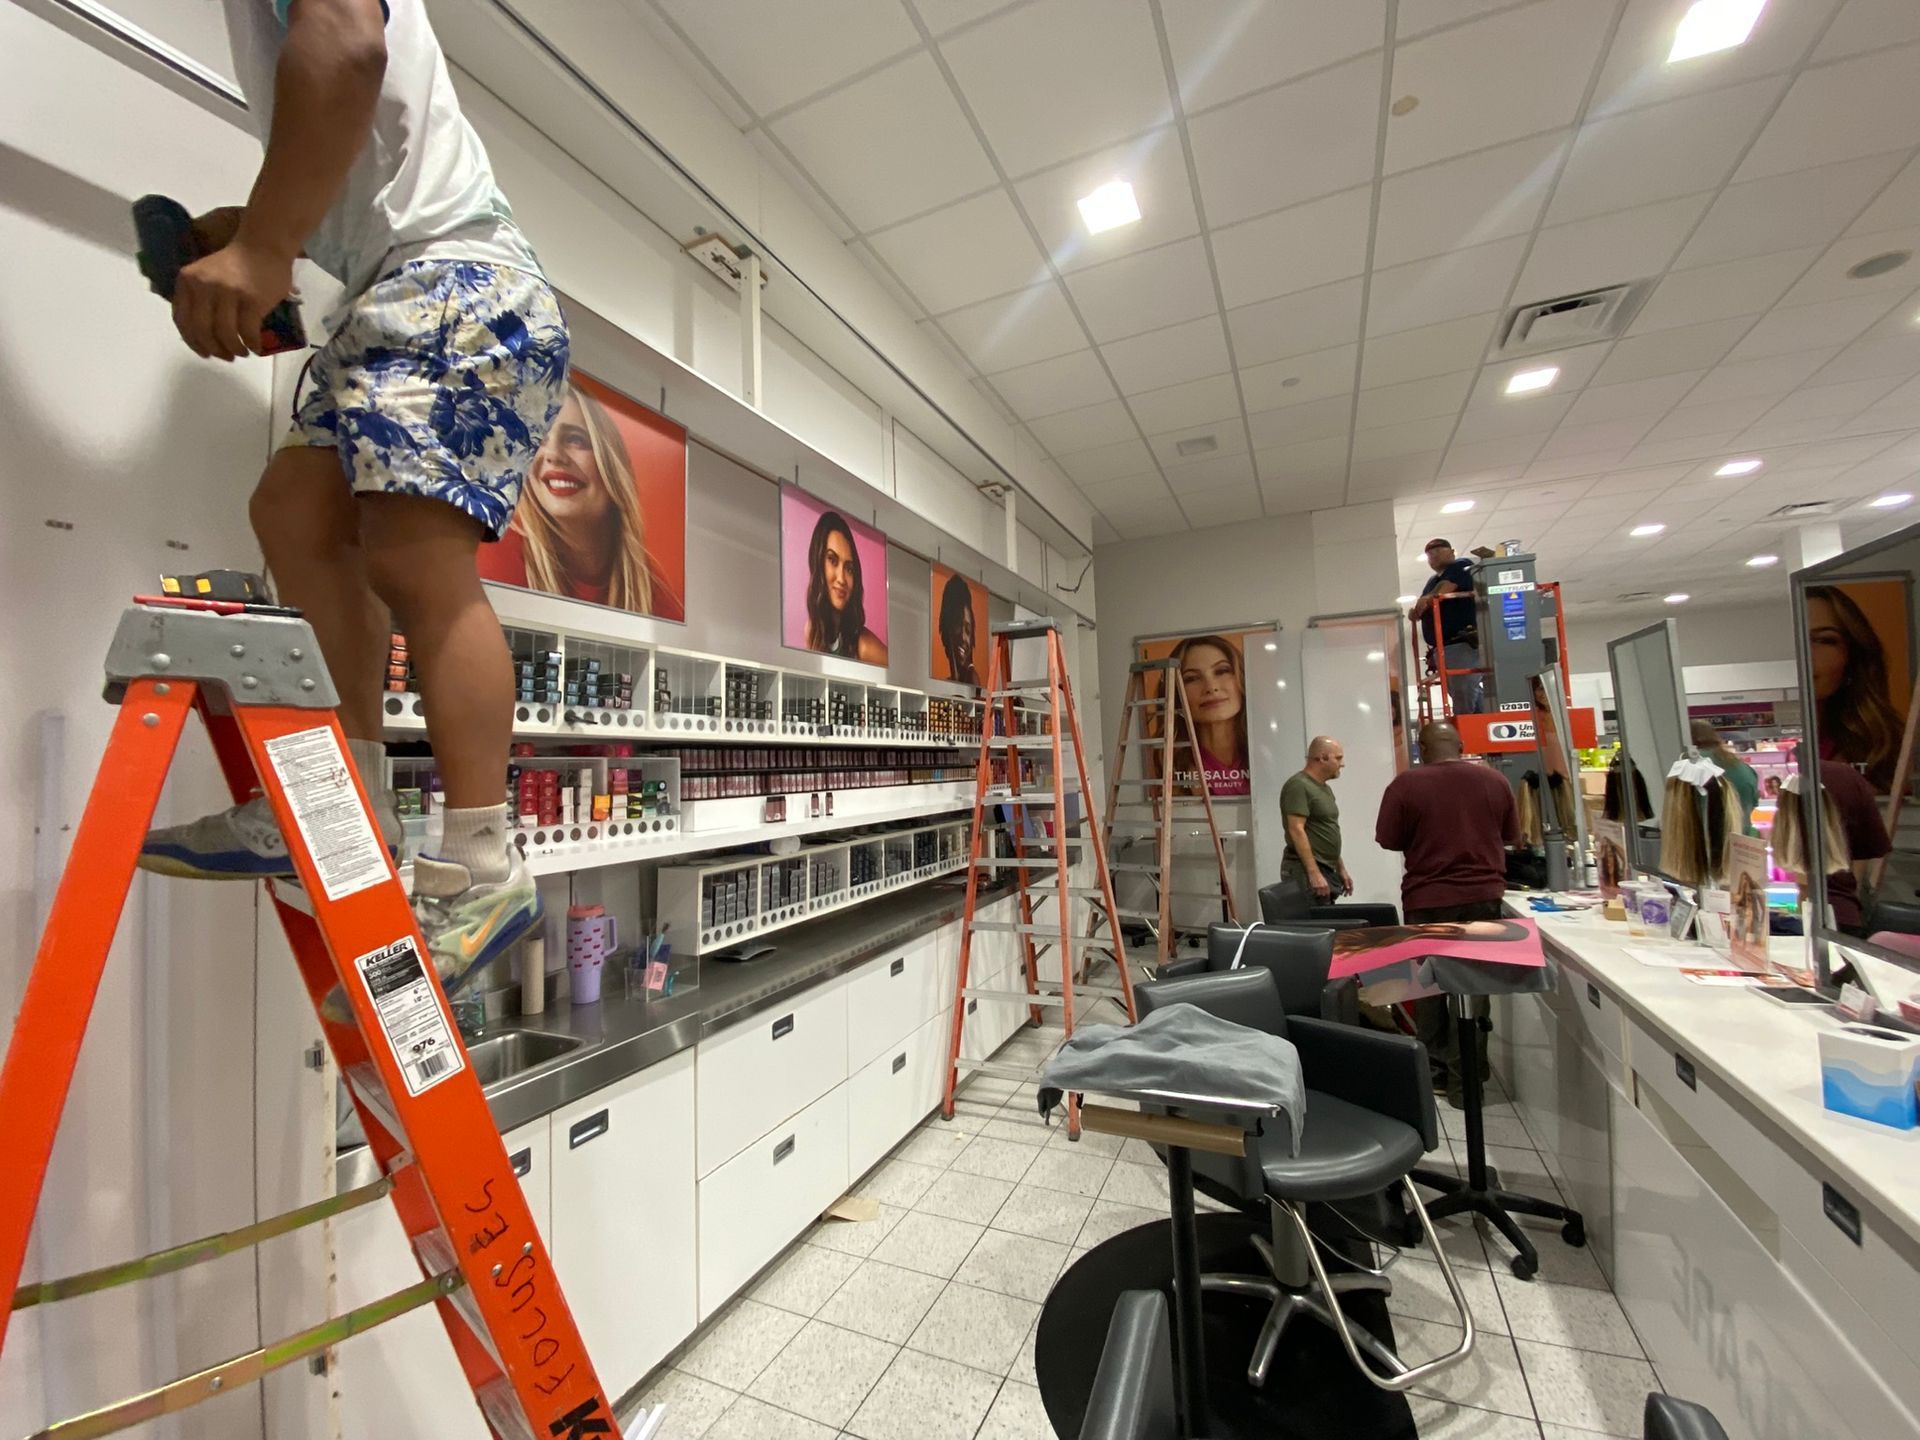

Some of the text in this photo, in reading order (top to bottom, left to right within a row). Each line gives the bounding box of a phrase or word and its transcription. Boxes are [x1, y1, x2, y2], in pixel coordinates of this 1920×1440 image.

[1174, 769, 1250, 781] THE SALON
[366, 942, 408, 967] KELLER
[412, 1037, 436, 1054] 976
